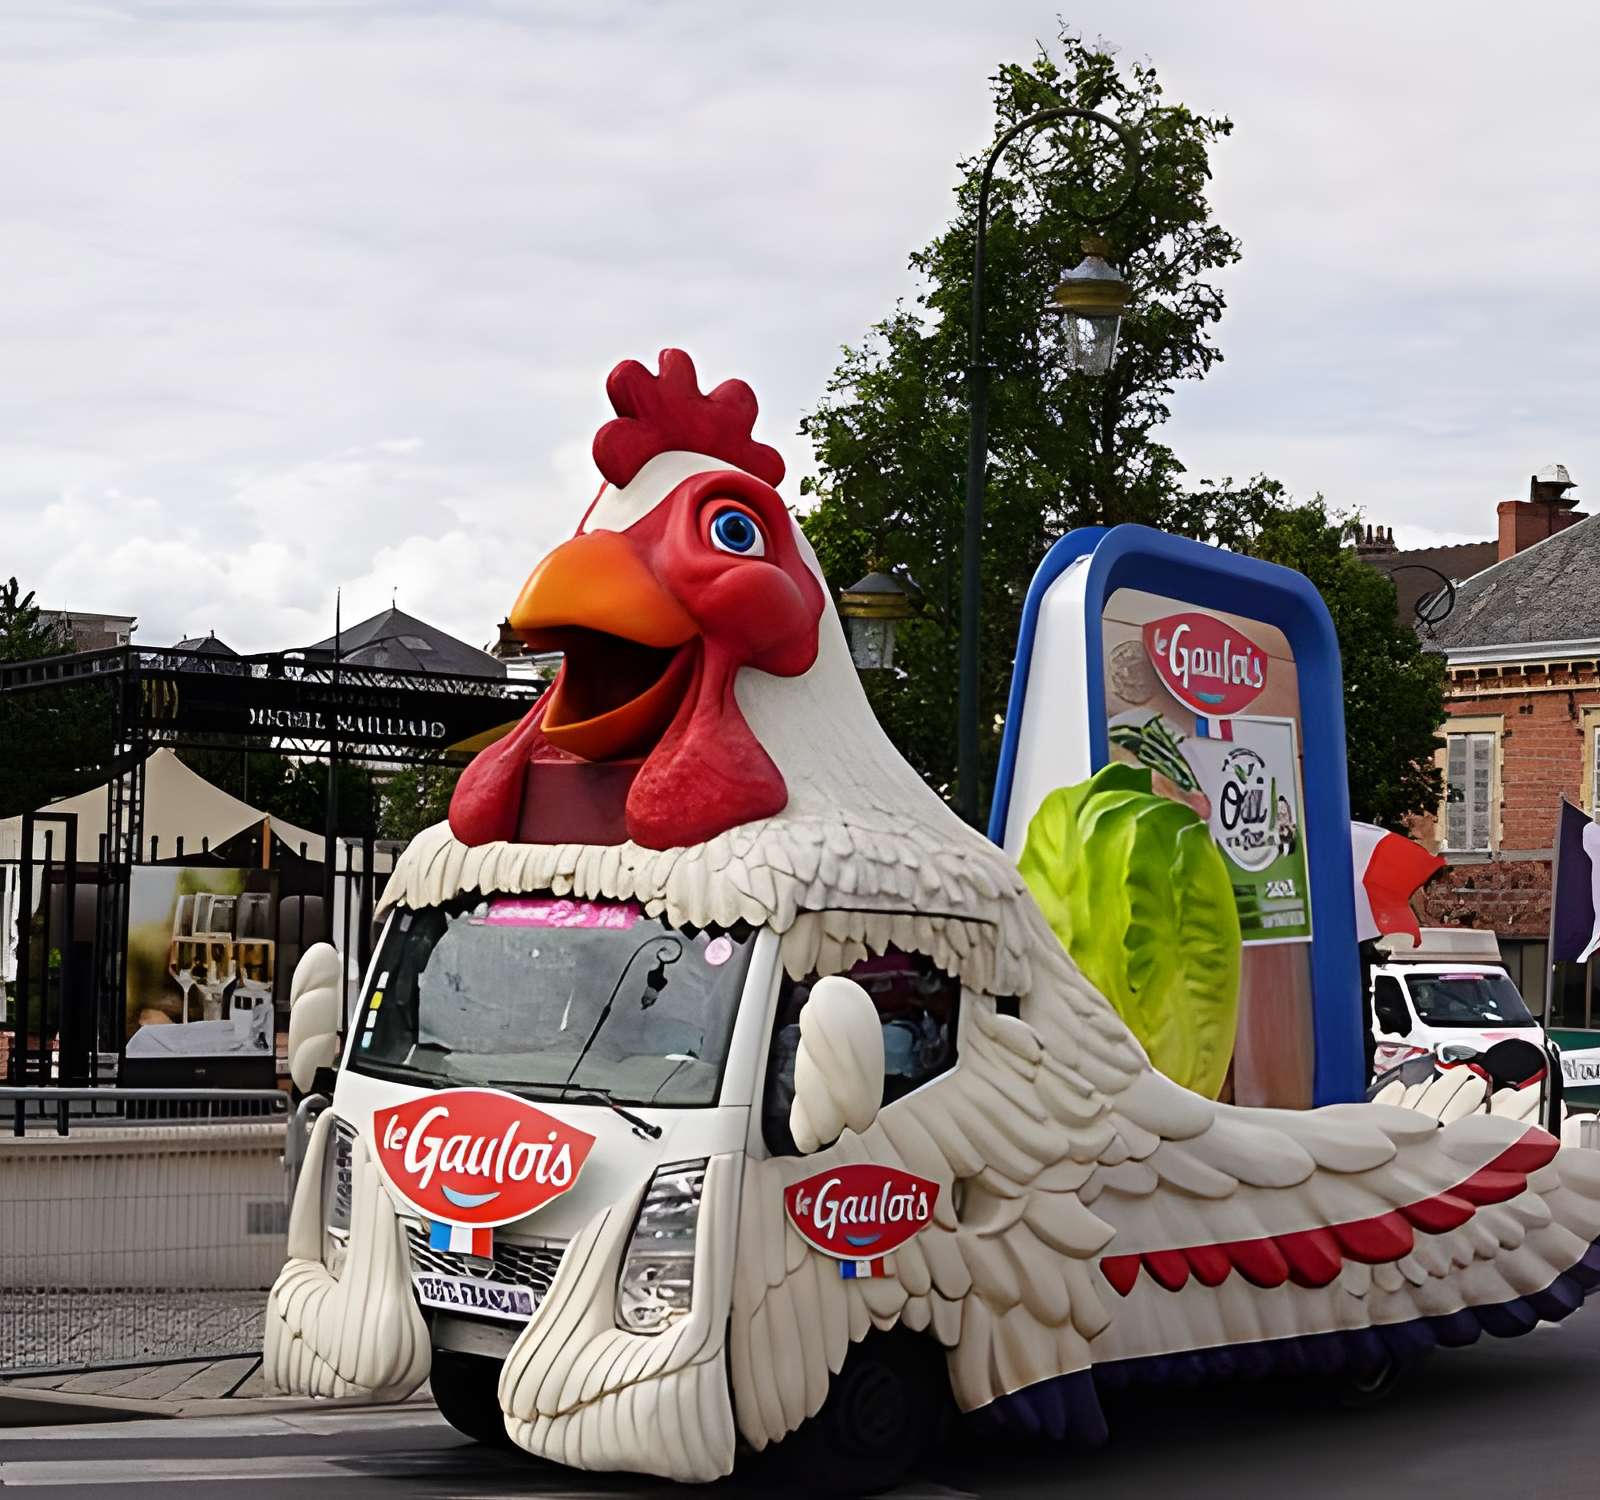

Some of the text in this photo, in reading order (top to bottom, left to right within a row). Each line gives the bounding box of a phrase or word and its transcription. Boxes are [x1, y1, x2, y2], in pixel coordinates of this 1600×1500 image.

[1168, 622, 1264, 689] Gaulois
[383, 1106, 572, 1190] le Gaulois
[813, 1178, 929, 1240] Gaulois
